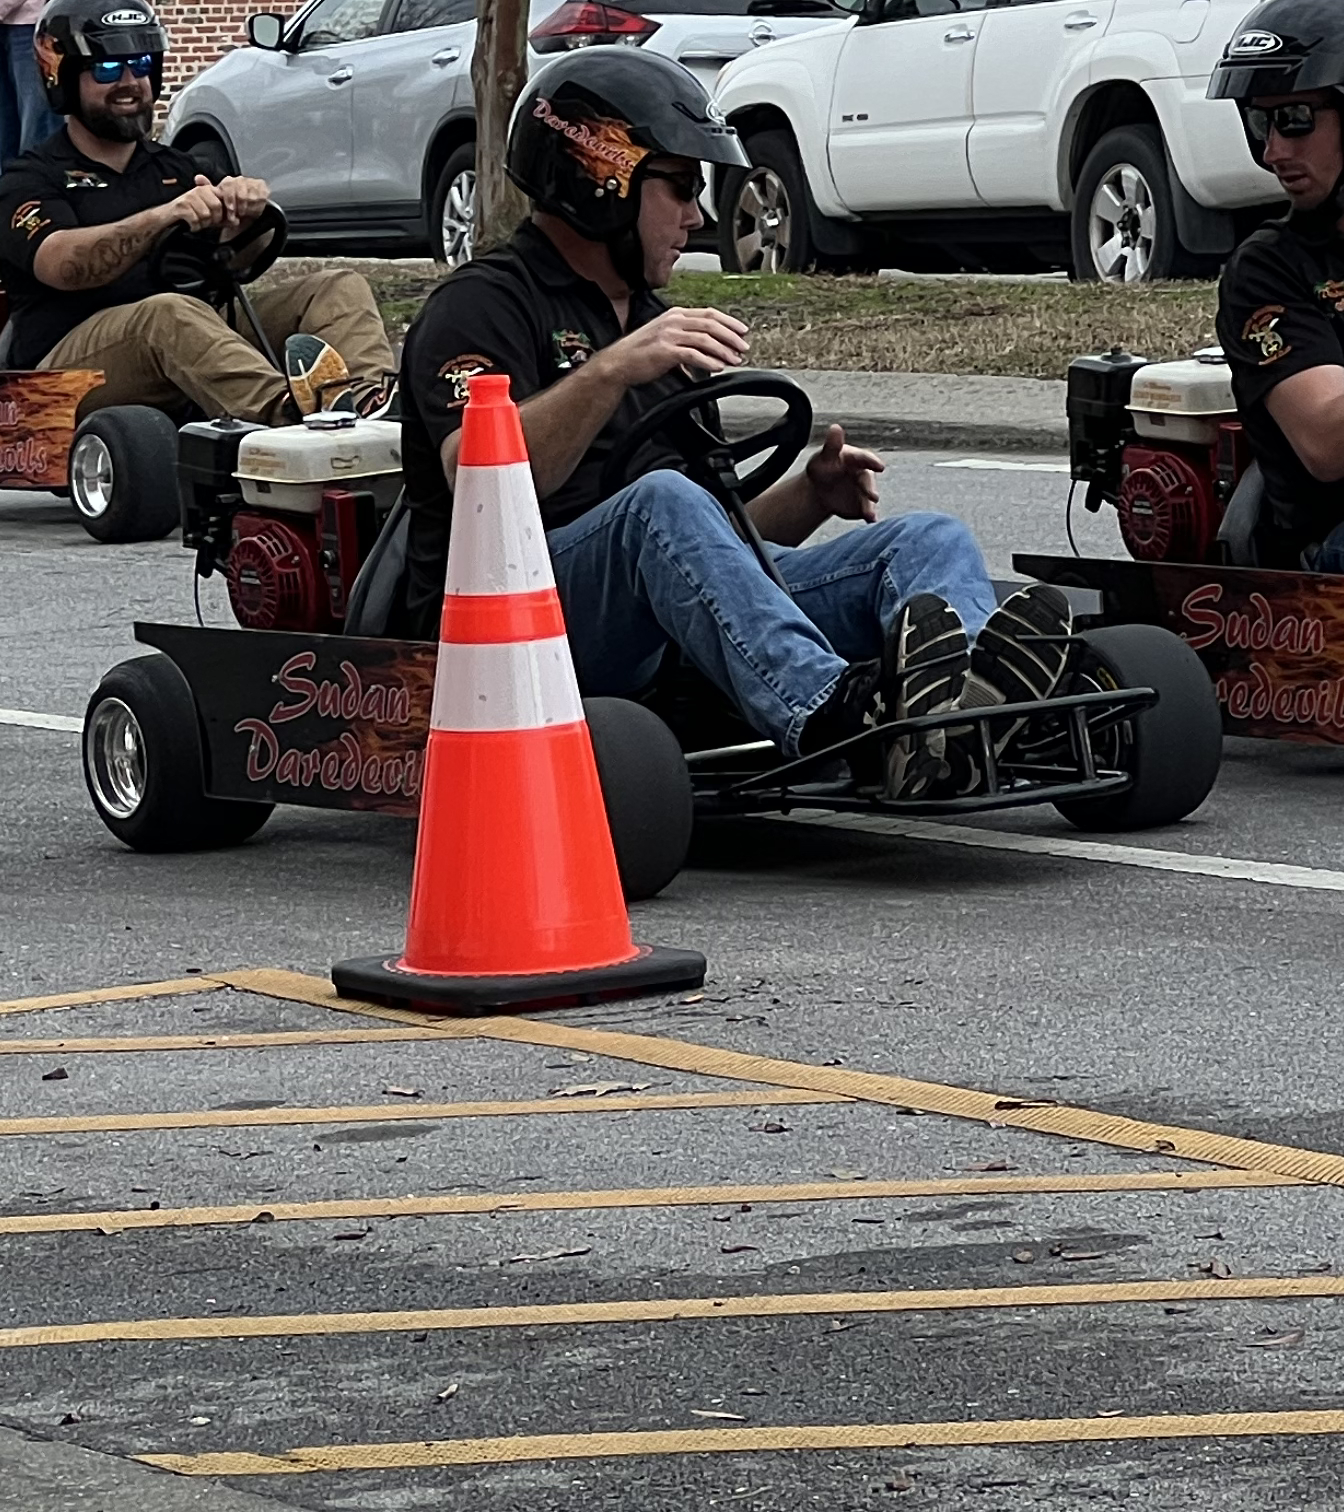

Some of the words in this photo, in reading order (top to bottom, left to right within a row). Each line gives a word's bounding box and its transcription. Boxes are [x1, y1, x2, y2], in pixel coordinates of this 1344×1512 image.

[1181, 583, 1326, 654] Sudan
[269, 651, 409, 723] Sudan
[234, 718, 427, 796] Daredevi
